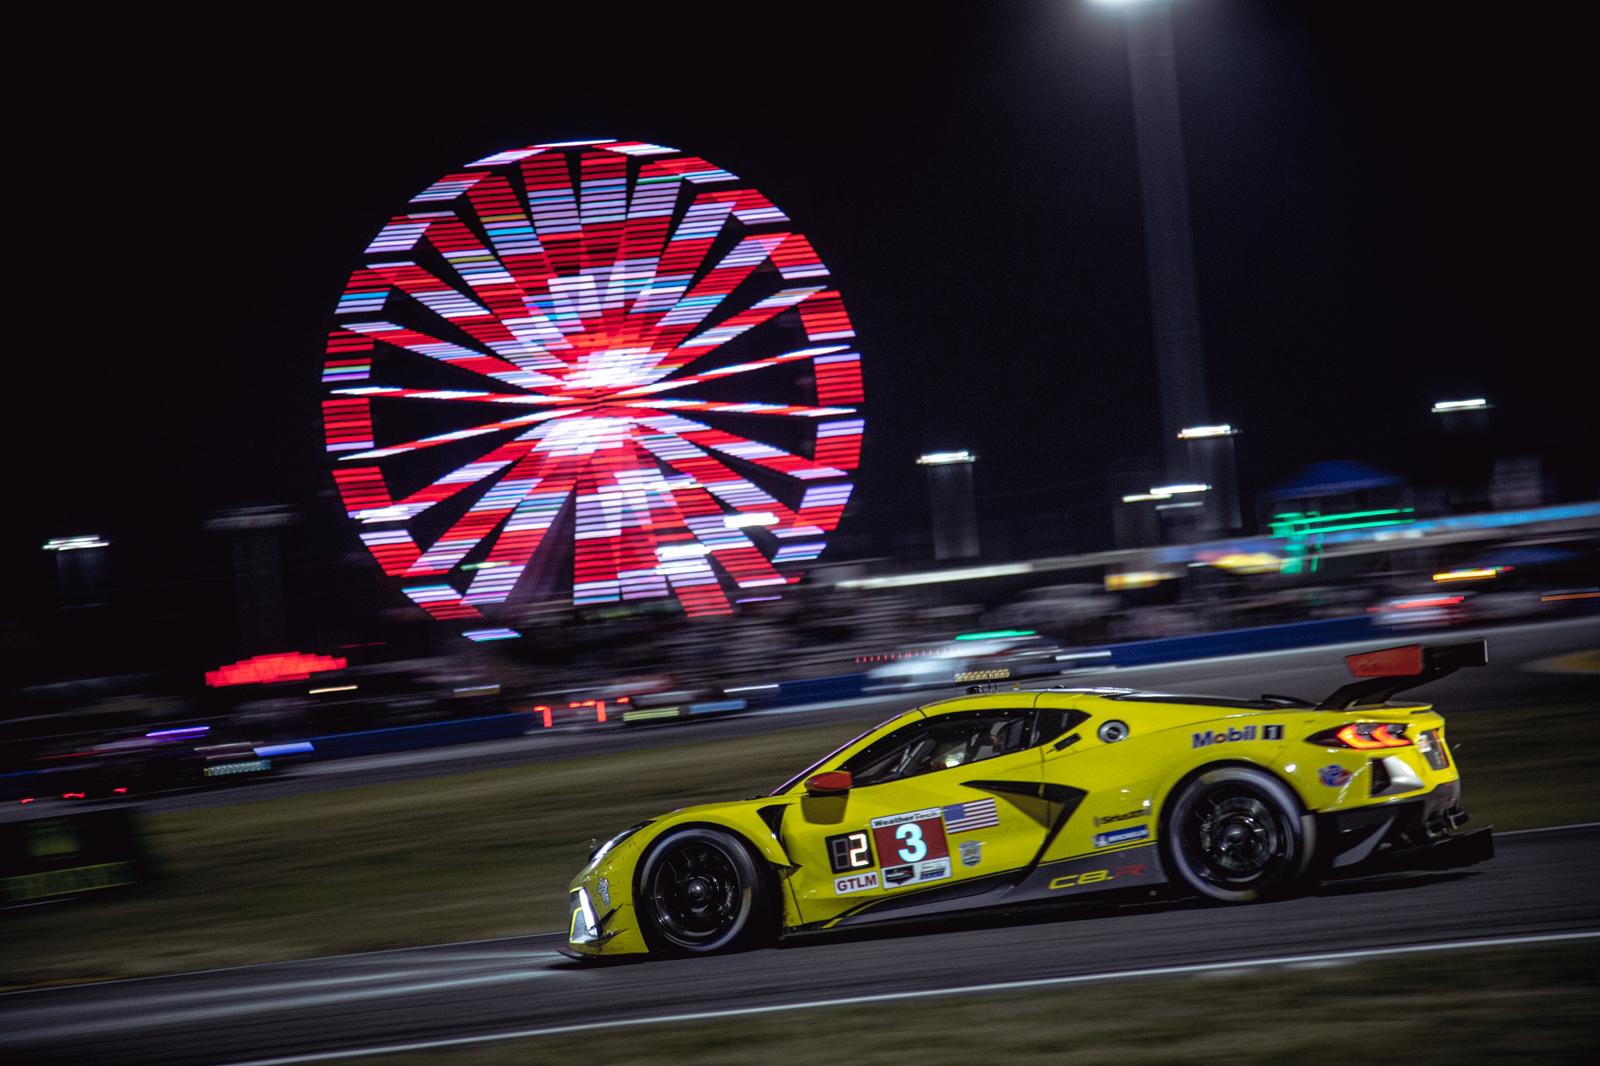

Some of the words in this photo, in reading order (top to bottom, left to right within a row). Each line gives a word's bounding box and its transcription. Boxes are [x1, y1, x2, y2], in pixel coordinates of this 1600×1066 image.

[1192, 725, 1257, 749] Mobil
[874, 810, 938, 827] WeatherTech
[849, 833, 869, 867] 2
[896, 823, 928, 863] 3
[837, 875, 877, 892] GTLM
